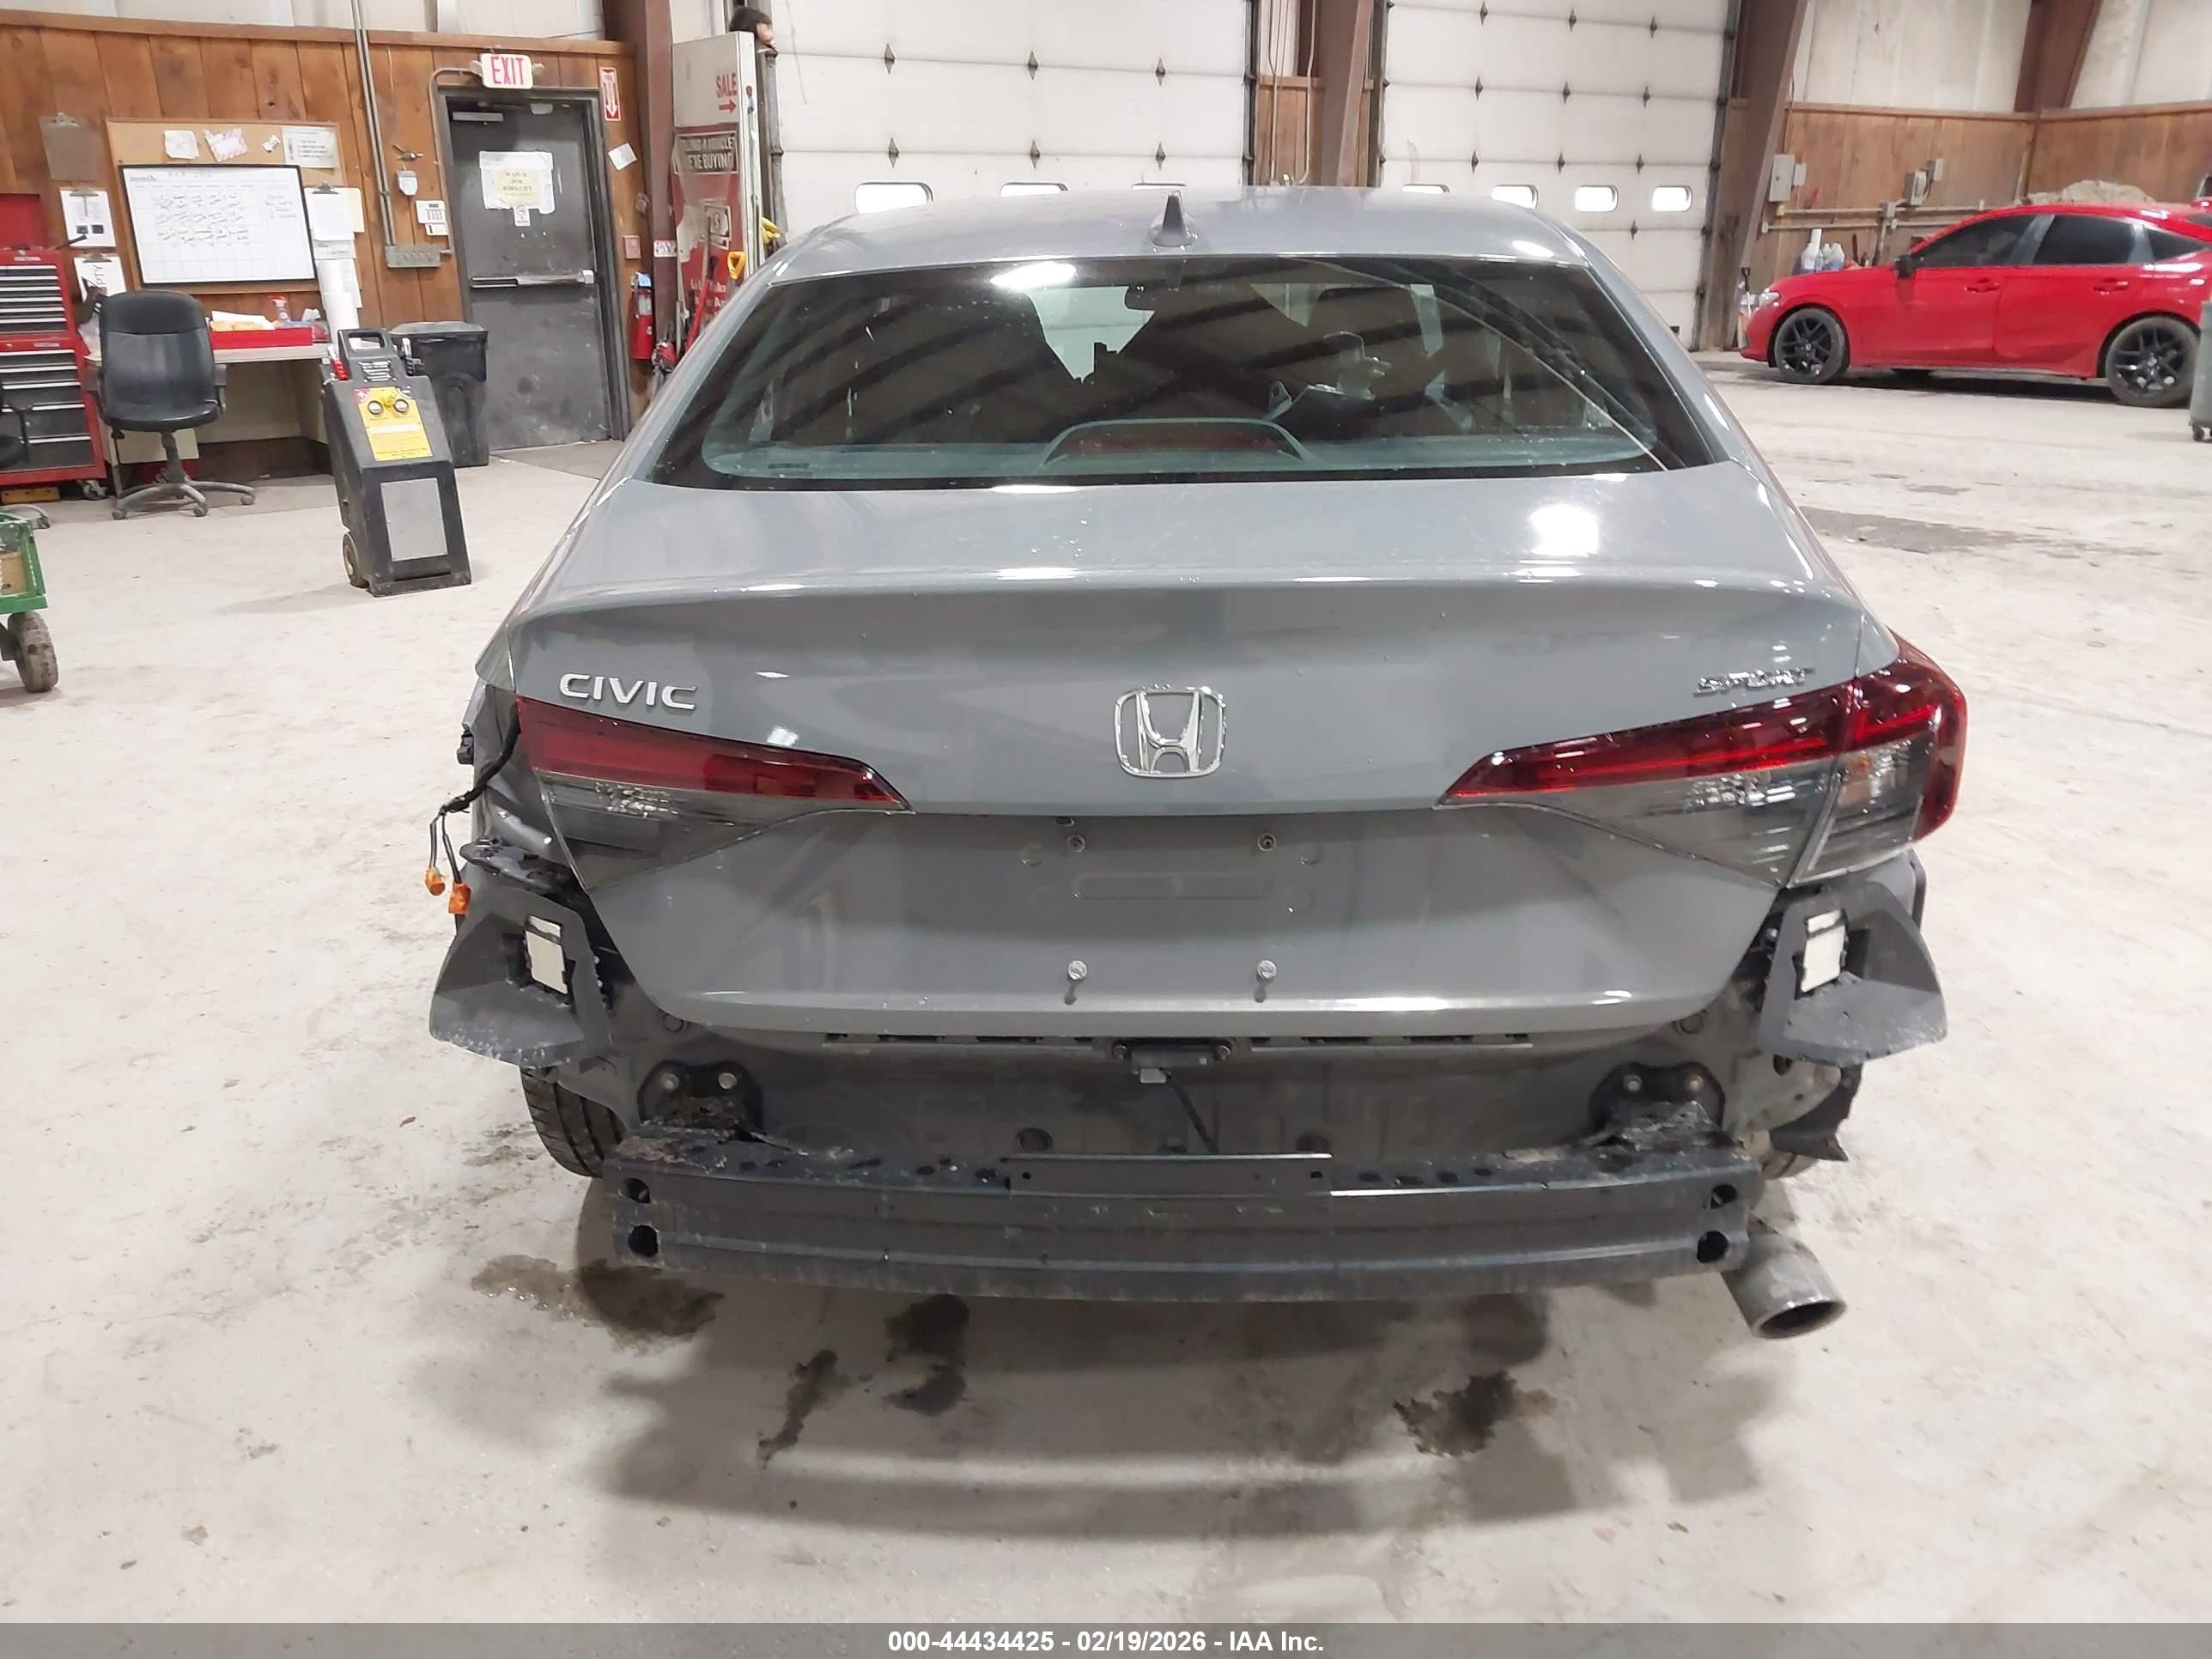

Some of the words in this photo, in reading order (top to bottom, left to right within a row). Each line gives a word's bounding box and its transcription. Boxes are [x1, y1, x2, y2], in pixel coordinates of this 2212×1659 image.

[490, 56, 524, 85] EXIT
[715, 73, 738, 98] SALE
[92, 264, 106, 285] PTY
[560, 673, 696, 710] CIVIC
[1693, 667, 1815, 696] SPORT
